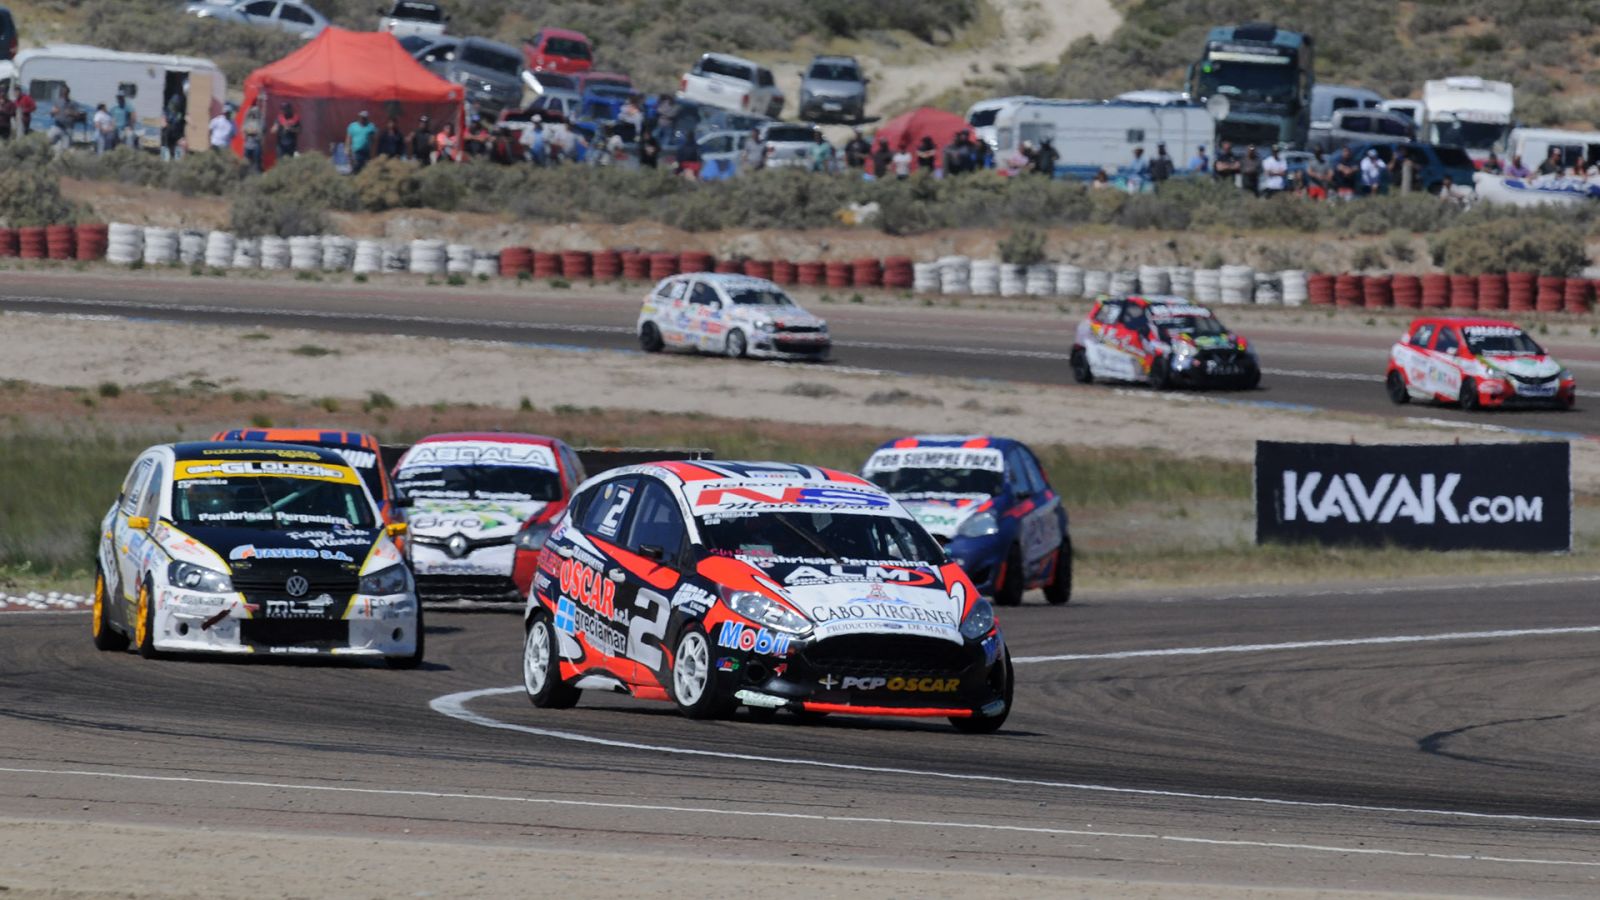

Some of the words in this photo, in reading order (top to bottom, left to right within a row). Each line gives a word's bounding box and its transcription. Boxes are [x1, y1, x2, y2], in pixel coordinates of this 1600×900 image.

[602, 490, 631, 528] 2
[719, 501, 889, 512] Motorsport
[1283, 470, 1543, 524] KAVAK.COM
[199, 511, 273, 521] Parabrisas
[560, 558, 615, 621] OSCAR
[575, 610, 625, 652] greciamar
[626, 587, 671, 672] 2
[812, 605, 864, 623] CABO
[826, 622, 884, 634] PRODUCTOS
[907, 622, 923, 631] DE
[925, 625, 949, 635] MAR
[718, 620, 790, 655] Mobil
[841, 676, 887, 690] PCP
[887, 677, 960, 692] OSCAR
